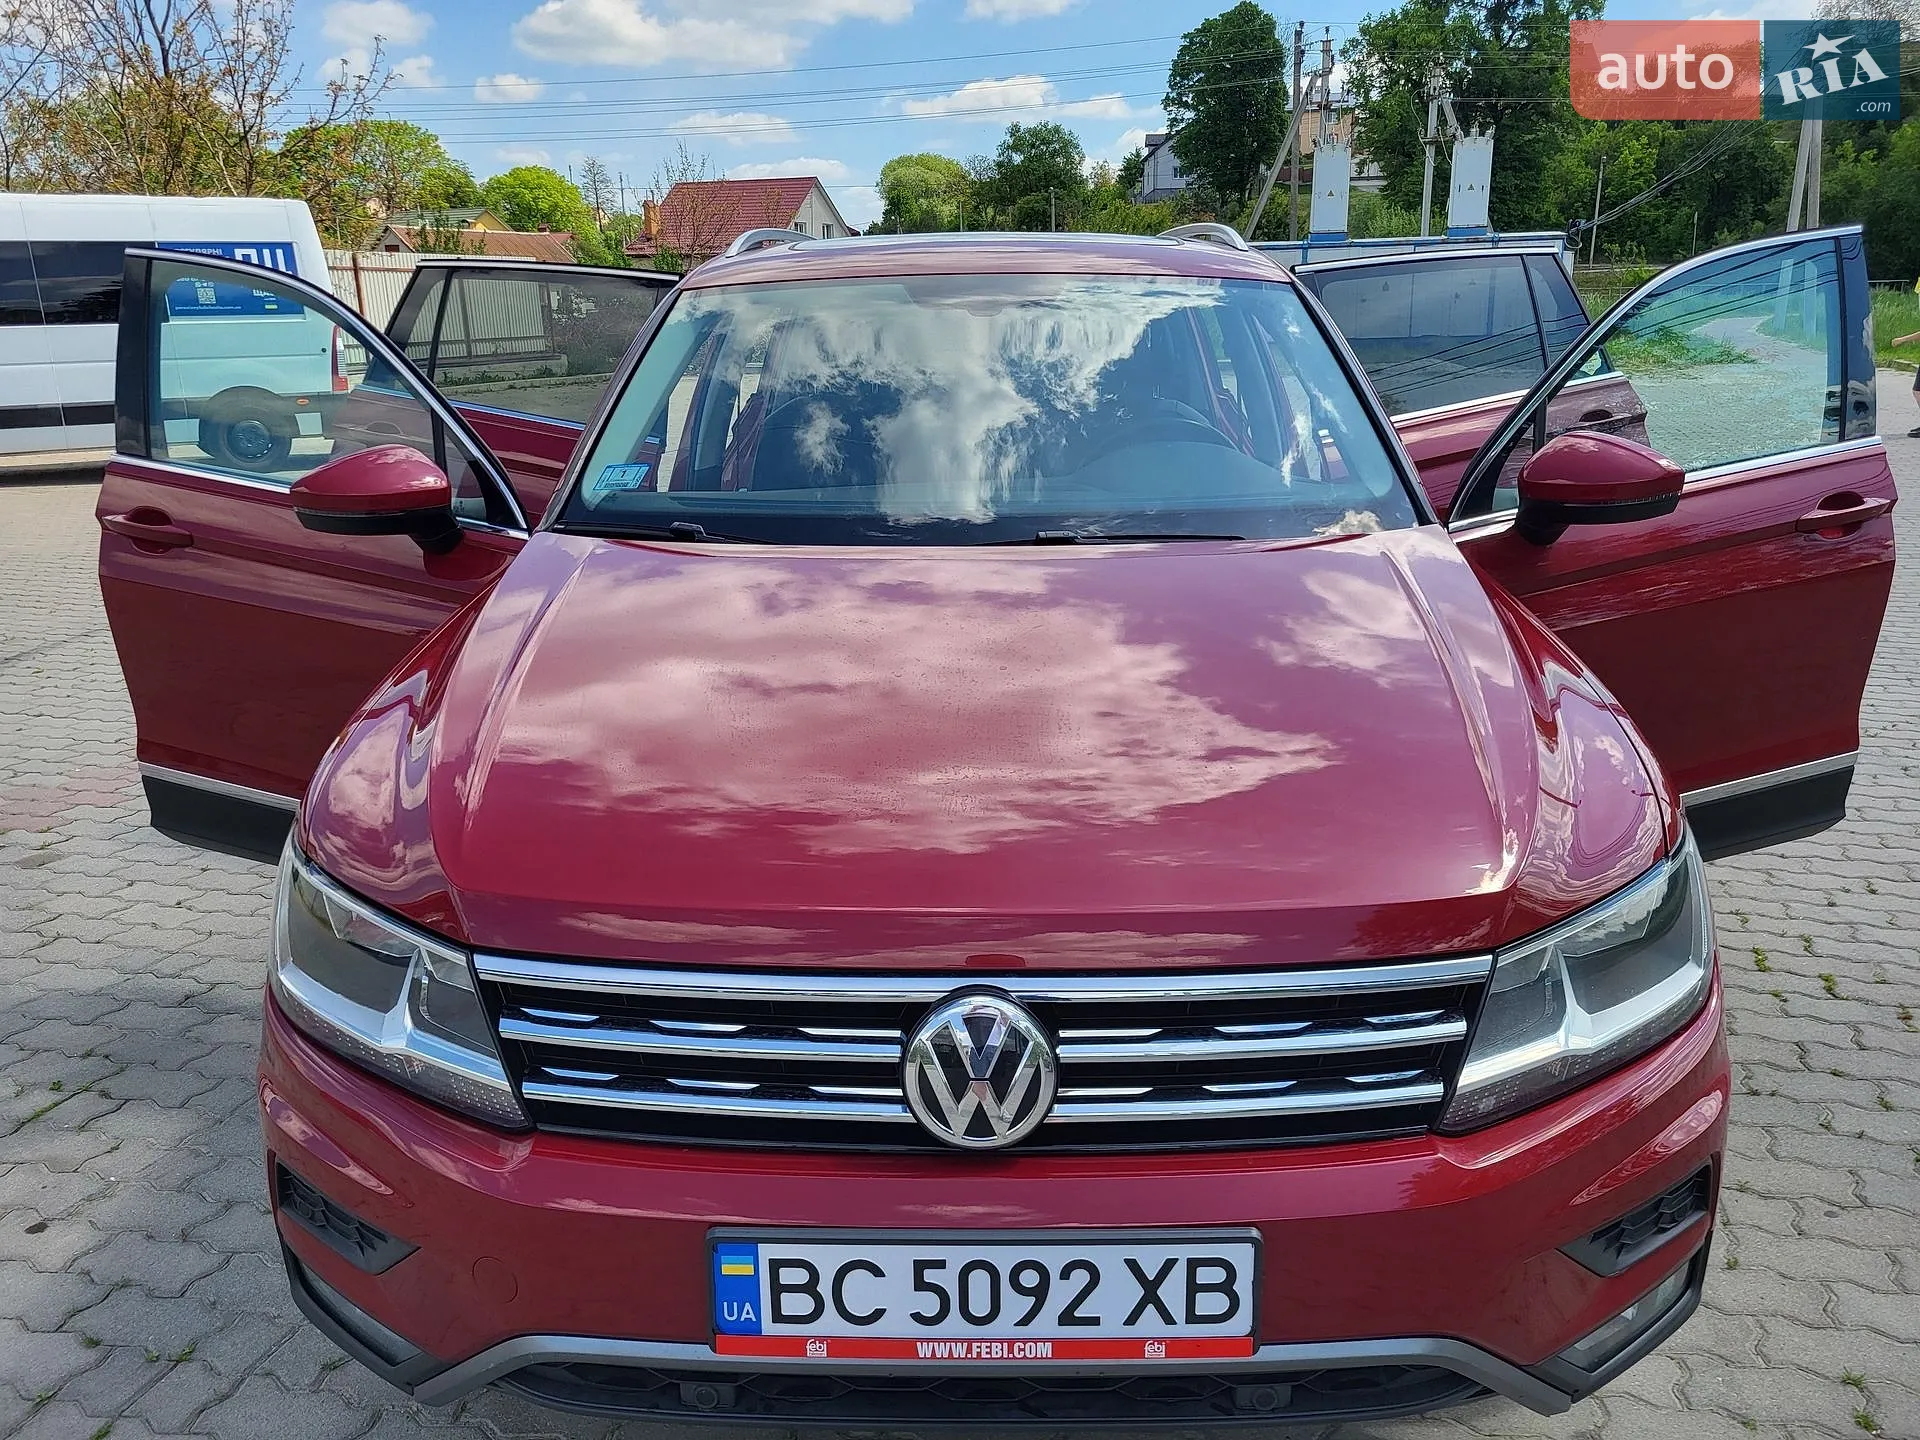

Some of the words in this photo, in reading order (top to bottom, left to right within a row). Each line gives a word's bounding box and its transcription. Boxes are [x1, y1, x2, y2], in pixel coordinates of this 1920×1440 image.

[768, 1257, 887, 1326] BC
[909, 1258, 1101, 1327] 5092
[1122, 1257, 1241, 1326] XB
[722, 1301, 757, 1322] UA
[806, 1339, 827, 1357] febi
[916, 1341, 1052, 1359] WWW.FEBI.COM
[1144, 1340, 1166, 1357] febi
